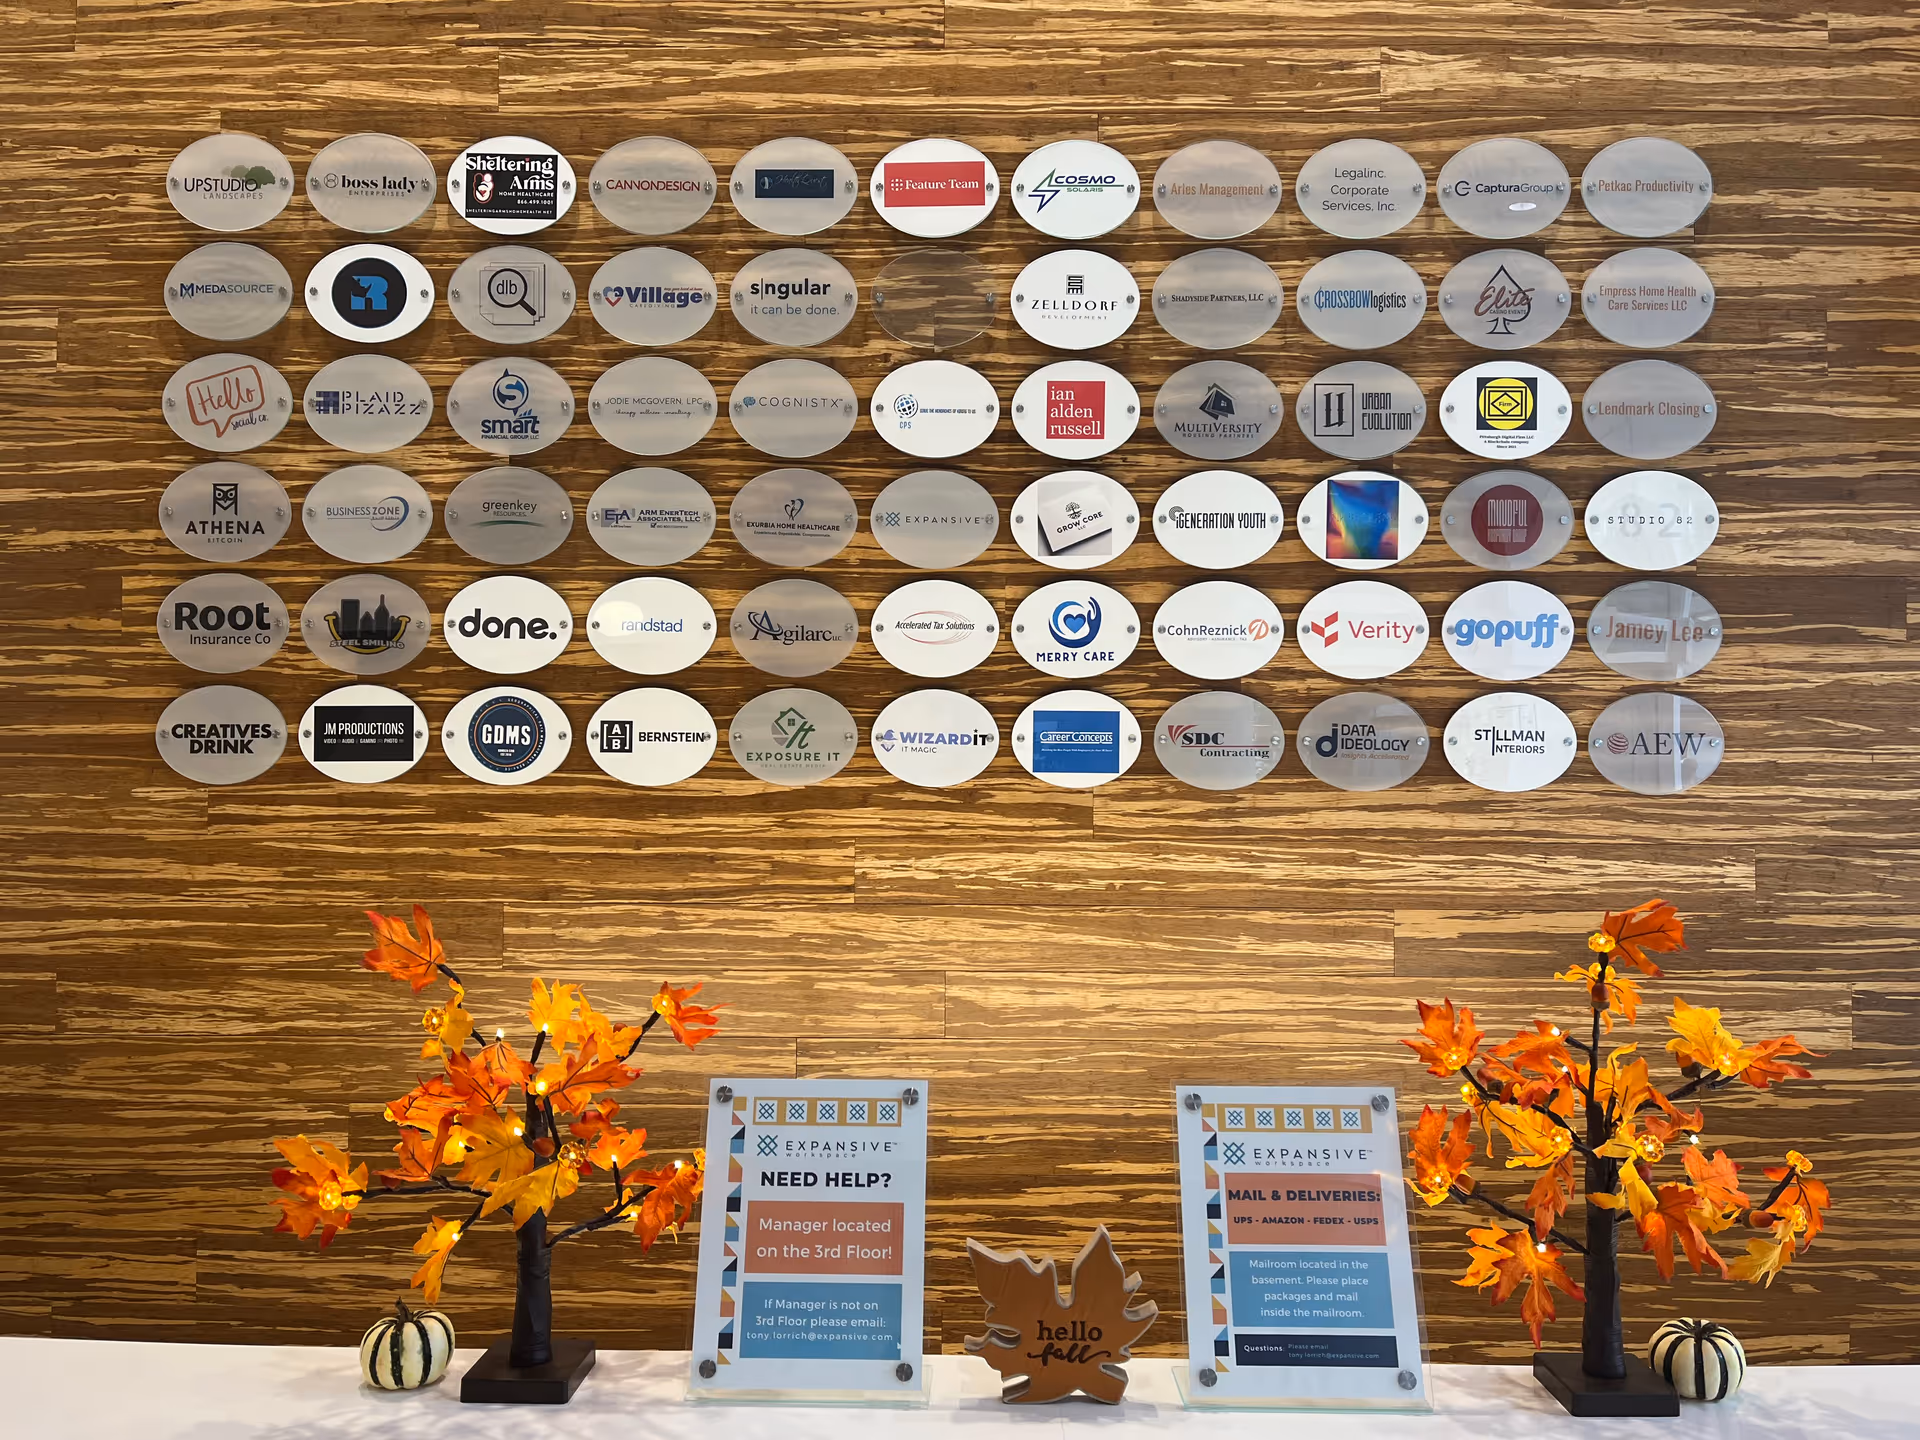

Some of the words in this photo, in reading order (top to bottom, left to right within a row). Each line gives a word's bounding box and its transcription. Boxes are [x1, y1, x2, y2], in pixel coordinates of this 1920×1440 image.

[466, 156, 554, 178] Sheltering
[1054, 175, 1116, 184] COSMO
[1334, 168, 1386, 180] Legalinc.
[342, 176, 378, 190] boss
[382, 176, 418, 194] lady
[510, 176, 554, 190] Arms
[606, 180, 700, 192] CANNONDESIGN
[906, 179, 946, 190] Feature
[948, 178, 979, 189] Team
[1598, 180, 1632, 192] Petkac
[1635, 180, 1694, 193] Productivity
[1200, 183, 1264, 197] Management
[1330, 185, 1389, 198] Corporate
[1377, 201, 1397, 211] Inc.
[625, 286, 702, 308] Village
[1600, 285, 1636, 298] Empress
[1639, 286, 1664, 296] Home
[1667, 286, 1696, 296] Health
[1032, 300, 1118, 311] ZELLDORF
[1474, 286, 1535, 316] Elite
[1608, 300, 1629, 310] Care
[1632, 300, 1668, 310] Services
[1671, 300, 1687, 310] LLC
[751, 304, 758, 315] it
[762, 306, 783, 315] can
[786, 304, 802, 315] be
[805, 304, 840, 315] done.
[198, 377, 255, 416] Hello
[342, 391, 404, 402] PLAID
[1051, 386, 1075, 400] ian
[342, 404, 421, 415] PIZAZZ
[1051, 404, 1093, 418] alden
[1599, 402, 1654, 415] Lendmark
[1658, 402, 1700, 418] Closing
[481, 416, 540, 434] smart
[1051, 421, 1101, 435] russell
[326, 506, 370, 516] BUSINESS
[372, 506, 400, 515] ZONE
[482, 500, 537, 513] greenkey
[906, 516, 981, 524] EXPANSIVE
[1056, 520, 1080, 533] GROW
[1083, 511, 1103, 523] CORE
[1176, 513, 1234, 529] iGENERATION
[1238, 513, 1266, 529] YOUTH
[185, 521, 265, 535] ATHENA
[174, 602, 271, 631] Root
[459, 608, 557, 640] done.
[622, 618, 683, 633] randstad
[748, 610, 832, 646] Agilarc
[895, 621, 932, 630] Accelerated
[945, 622, 975, 631] Solutions
[1167, 624, 1247, 636] CohnReznick
[1606, 616, 1664, 643] Jamey
[1672, 619, 1703, 642] Lee
[1348, 621, 1415, 643] Verity
[1455, 614, 1559, 648] gopuff
[190, 634, 250, 645] Insurance
[255, 634, 271, 645] Co
[330, 639, 360, 648] STEEL
[362, 639, 404, 649] SMILING
[1036, 652, 1078, 662] MERRY
[1084, 651, 1114, 661] CARE
[171, 724, 272, 739] CREATIVES
[324, 723, 336, 735] JM
[338, 723, 404, 735] PRODUCTIONS
[482, 724, 531, 746] GDMS
[1341, 725, 1376, 736] DATA
[638, 732, 704, 742] BERNSTEIN
[1040, 732, 1070, 742] Career
[1072, 732, 1113, 744] Concepts
[1181, 732, 1224, 745] SDC
[1629, 732, 1706, 755] AEW
[190, 739, 254, 754] DRINK
[1341, 738, 1410, 751] IDEOLOGY
[746, 752, 820, 761] EXPOSURE
[828, 752, 840, 761] IT
[1200, 748, 1270, 758] Contracting
[761, 1171, 818, 1187] NEED
[826, 1172, 892, 1188] HELP?
[1228, 1190, 1266, 1200] MAIL
[1271, 1190, 1281, 1200] &
[1286, 1190, 1381, 1201] DELIVERIES:
[760, 1219, 828, 1234] Manager
[832, 1219, 891, 1232] located
[757, 1247, 777, 1257] on
[783, 1245, 809, 1258] the
[814, 1245, 841, 1258] 3rd
[847, 1246, 892, 1260] Floor!
[1249, 1260, 1296, 1269] Mailroom
[1300, 1260, 1336, 1269] located
[1339, 1260, 1349, 1269] in
[1352, 1260, 1368, 1269] the
[1252, 1276, 1303, 1285] basement.
[1306, 1276, 1339, 1285] Please
[1342, 1276, 1369, 1287] place
[1265, 1292, 1311, 1303] packages
[1314, 1292, 1333, 1301] and
[1336, 1293, 1358, 1301] mail
[765, 1299, 774, 1309] If
[776, 1300, 825, 1311] Manager
[829, 1300, 838, 1309] is
[842, 1301, 861, 1310] not
[1261, 1308, 1290, 1317] inside
[1294, 1308, 1310, 1317] the
[1313, 1309, 1365, 1318] mailroom.
[755, 1316, 772, 1326] 3rd
[778, 1316, 807, 1326] Floor
[810, 1317, 847, 1328] please
[850, 1317, 886, 1327] email:
[746, 1331, 893, 1342] tony.lorrich@expansive.com
[1037, 1320, 1103, 1341] hello
[1027, 1342, 1111, 1366] fall
